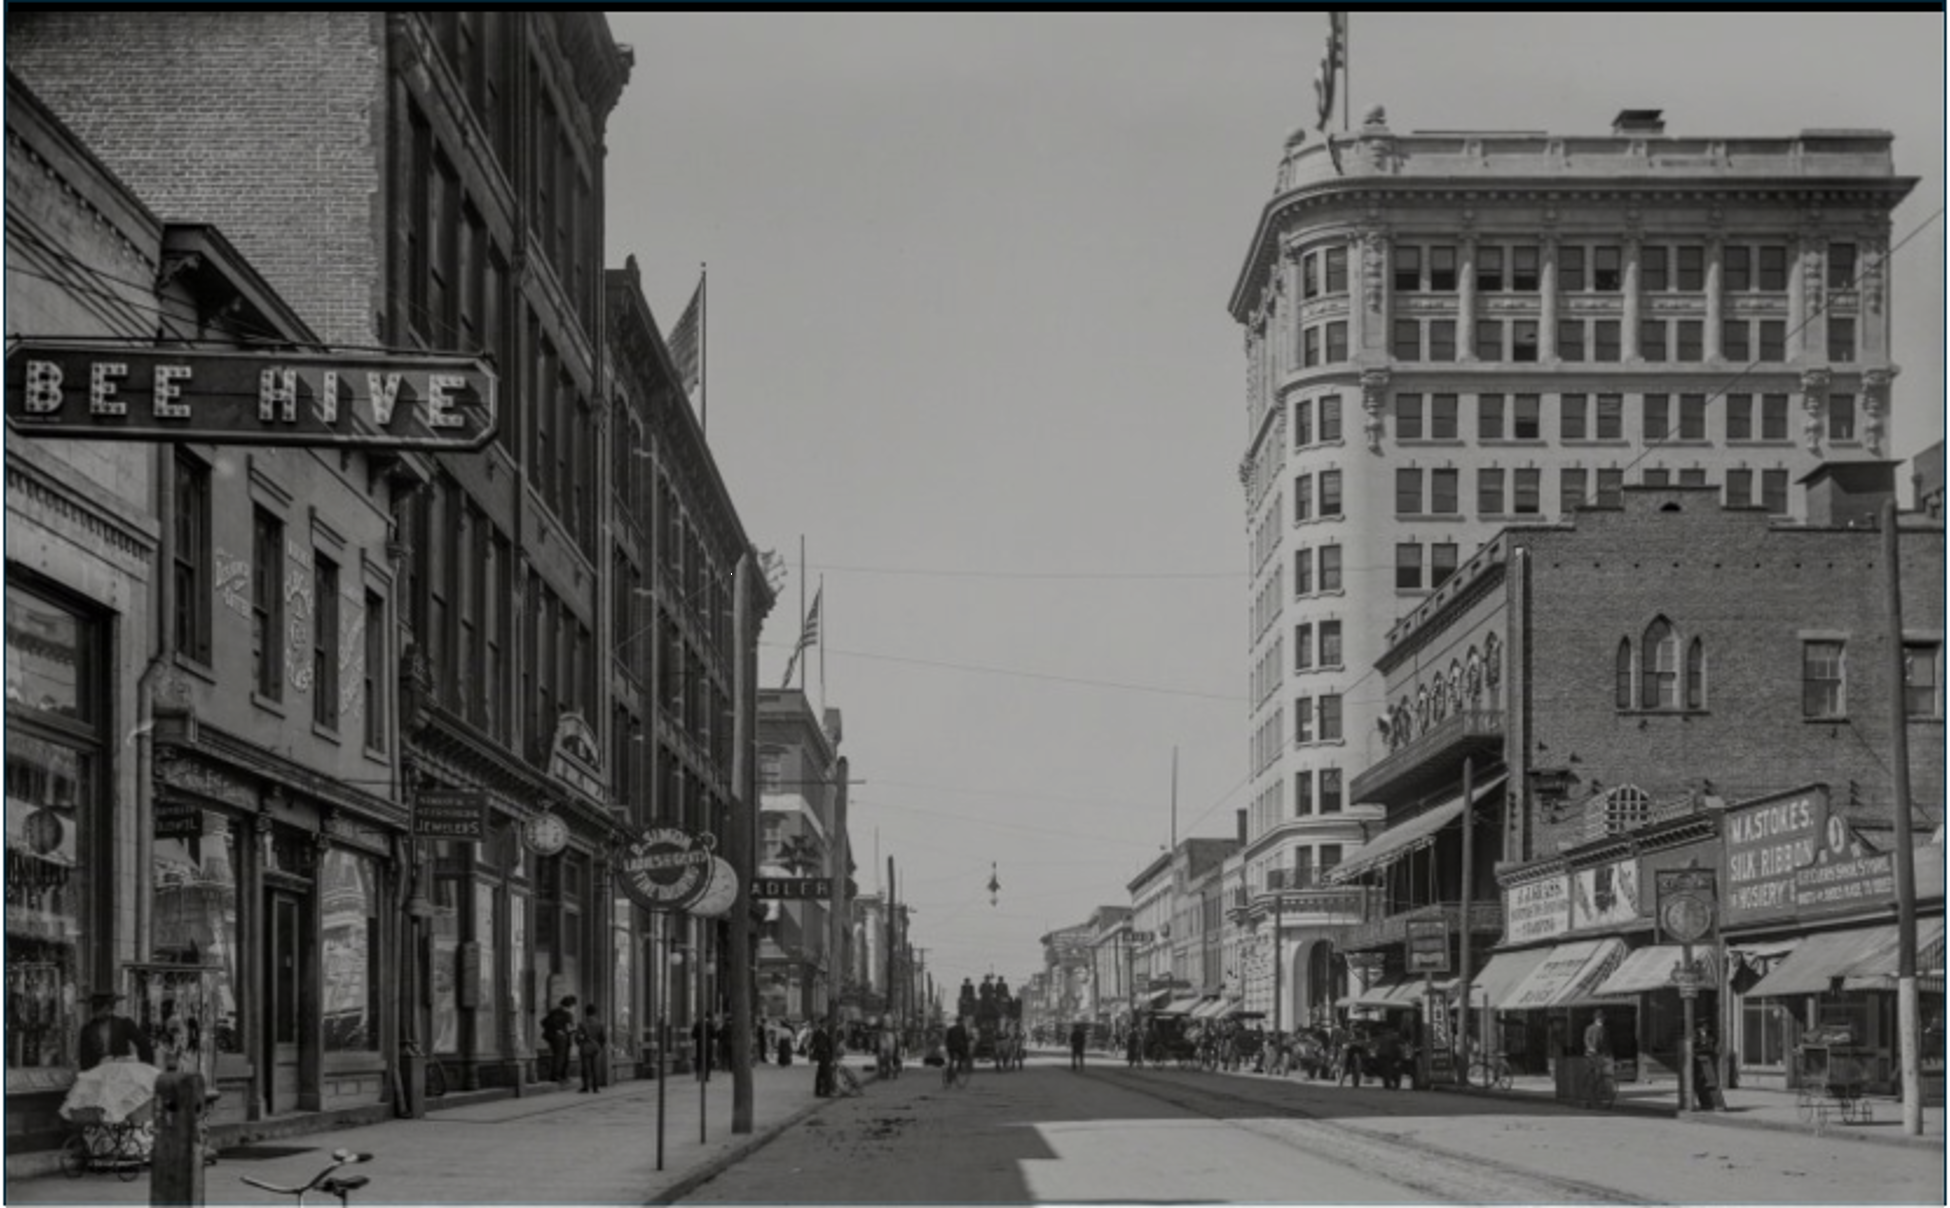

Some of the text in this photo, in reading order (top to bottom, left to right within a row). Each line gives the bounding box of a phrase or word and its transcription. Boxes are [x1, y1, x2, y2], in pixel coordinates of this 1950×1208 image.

[24, 360, 466, 427] BEE HIVE
[415, 819, 480, 834] JEWELERS
[1730, 851, 1757, 882] SILK
[1760, 839, 1815, 878] RIBBON
[751, 881, 829, 896] ADLER
